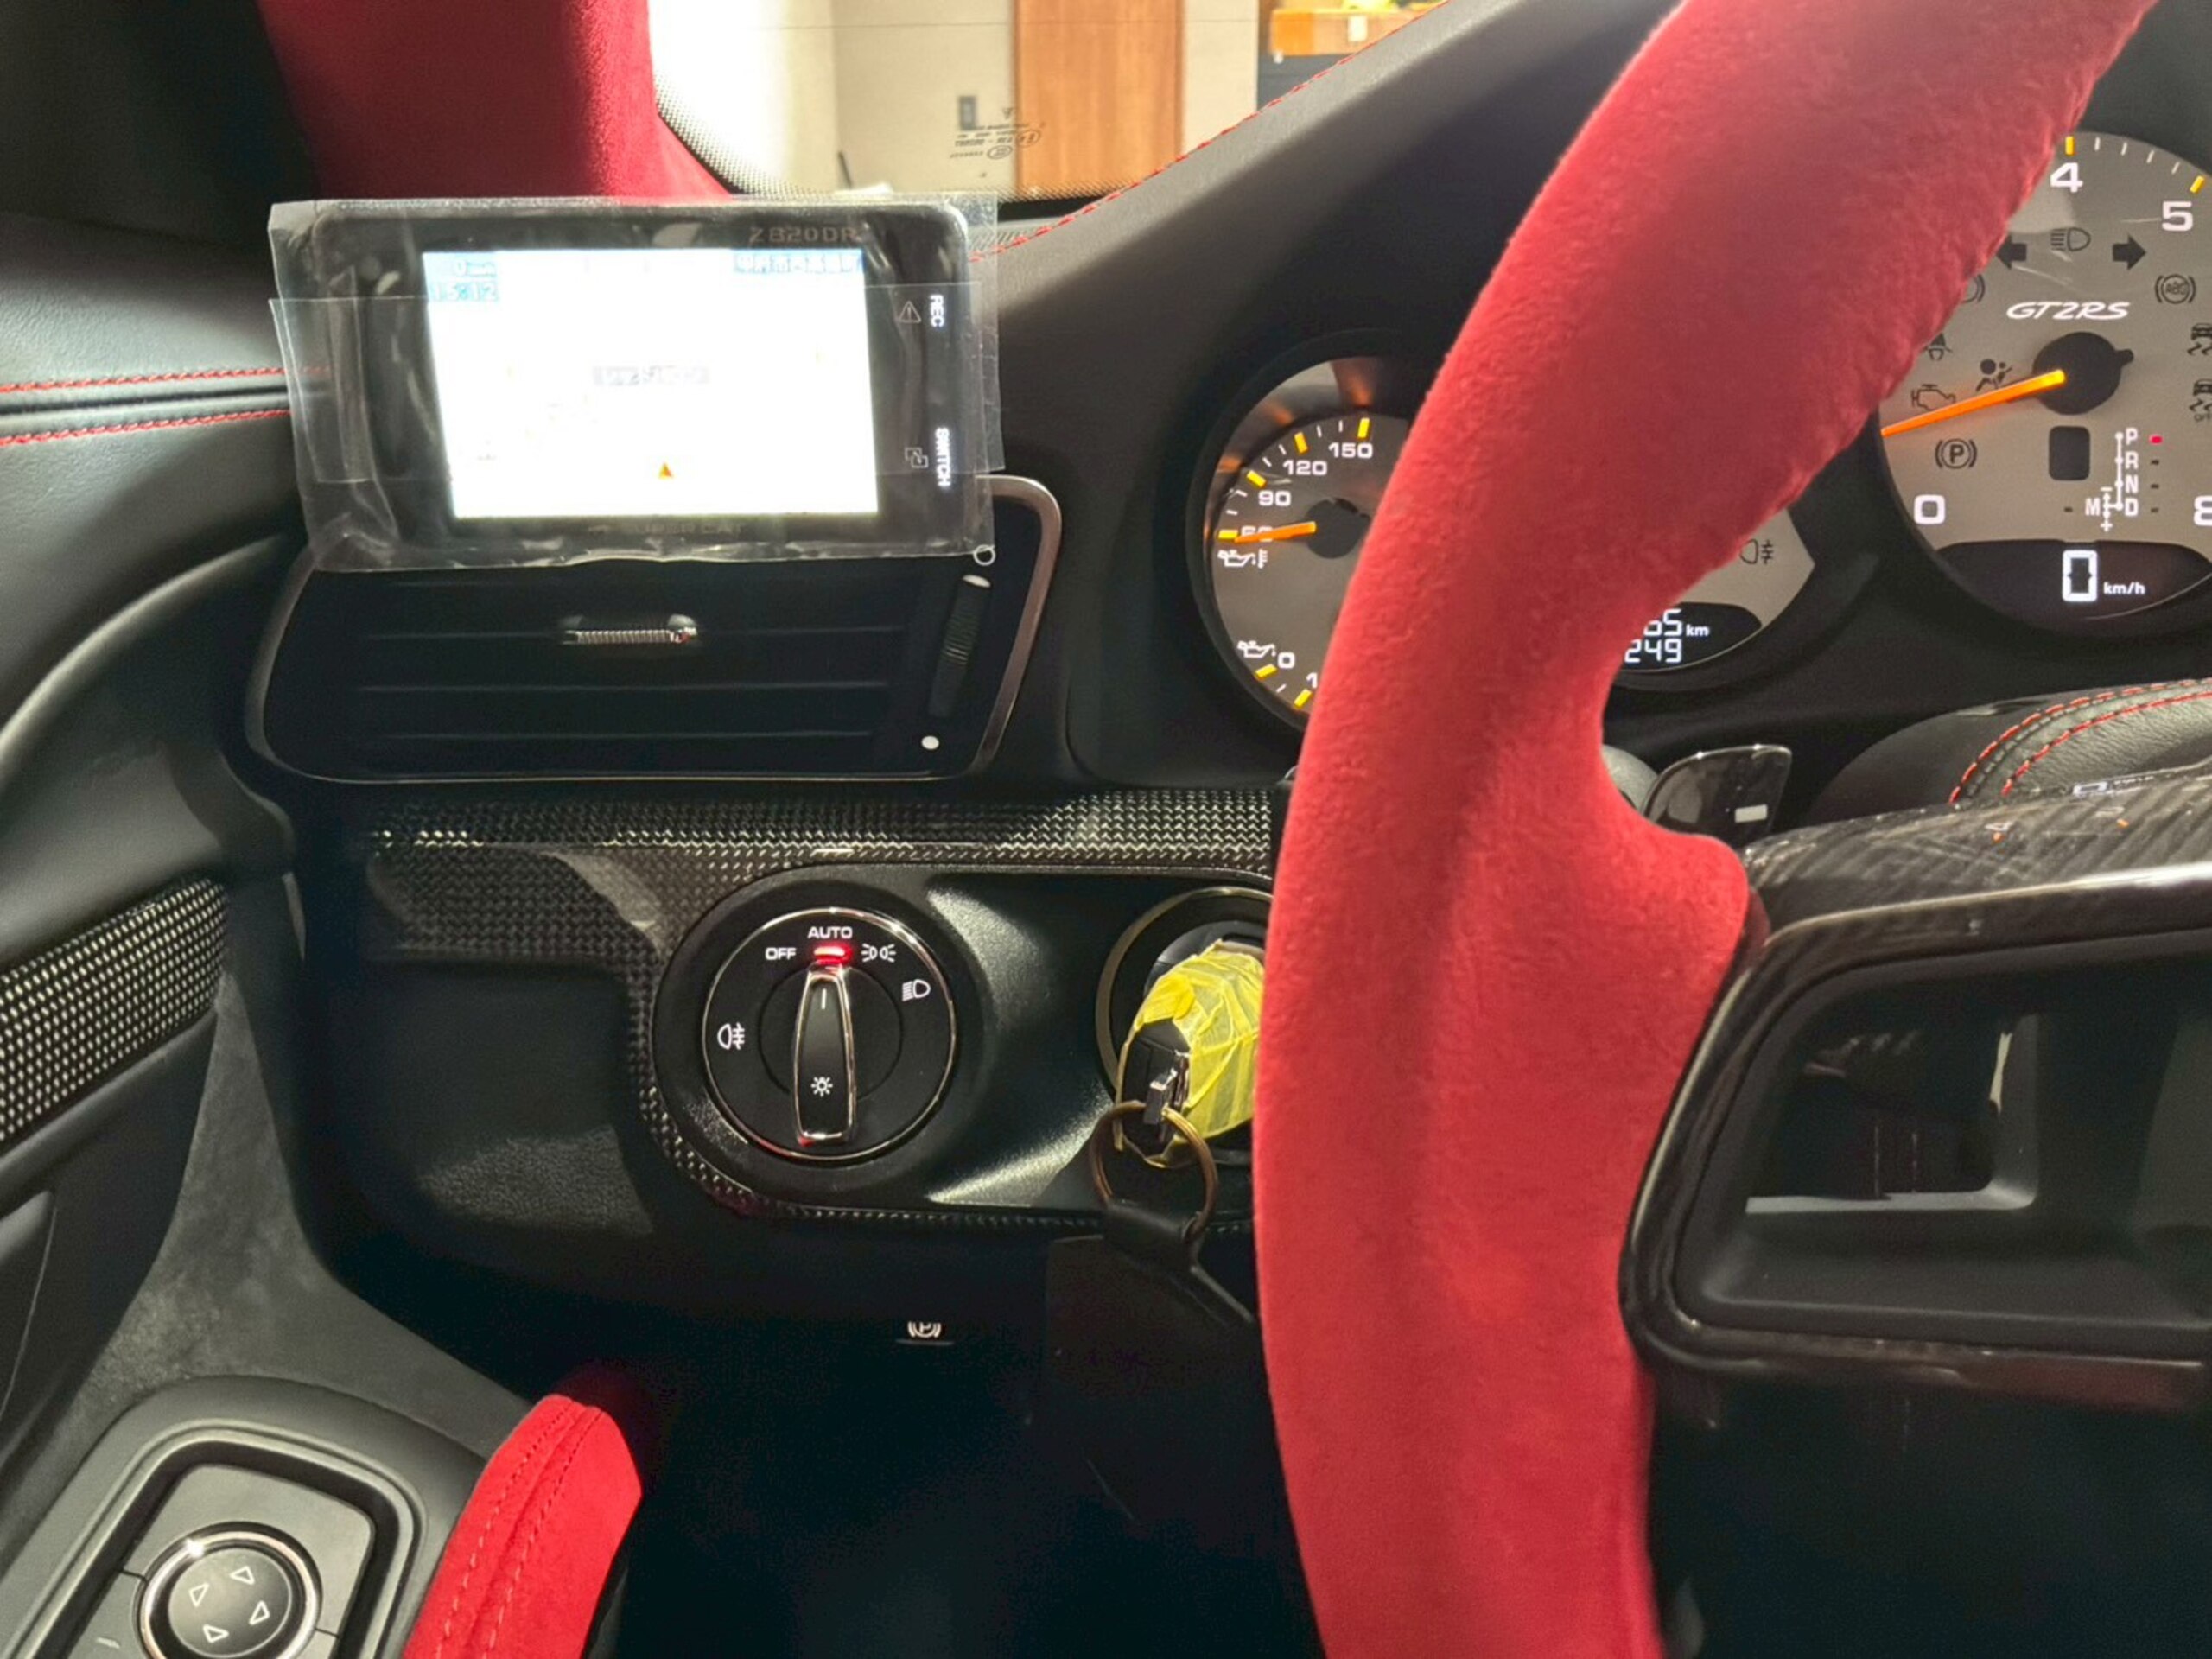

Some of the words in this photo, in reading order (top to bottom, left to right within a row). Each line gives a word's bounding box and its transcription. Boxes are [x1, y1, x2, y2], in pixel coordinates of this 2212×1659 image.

[2050, 162, 2083, 193] 4
[2162, 201, 2193, 231] 5
[929, 294, 945, 327] REC
[2006, 302, 2130, 320] GT2RS
[2126, 428, 2138, 445] P
[935, 427, 951, 487] SWITCH
[1329, 442, 1373, 459] 150
[1283, 460, 1328, 475] 120
[2125, 451, 2139, 469] R
[2125, 474, 2139, 493] N
[1258, 490, 1292, 506] 90
[2085, 498, 2101, 516] M
[2125, 498, 2139, 516] D
[1913, 493, 1945, 524] 0
[2062, 549, 2098, 601] 0
[2103, 582, 2146, 594] km/h
[1685, 624, 1710, 637] km
[1624, 638, 1683, 663] 249
[1278, 652, 1295, 669] 0
[1306, 672, 1318, 689] 1
[807, 925, 853, 939] AUTO
[765, 947, 797, 960] OFF
